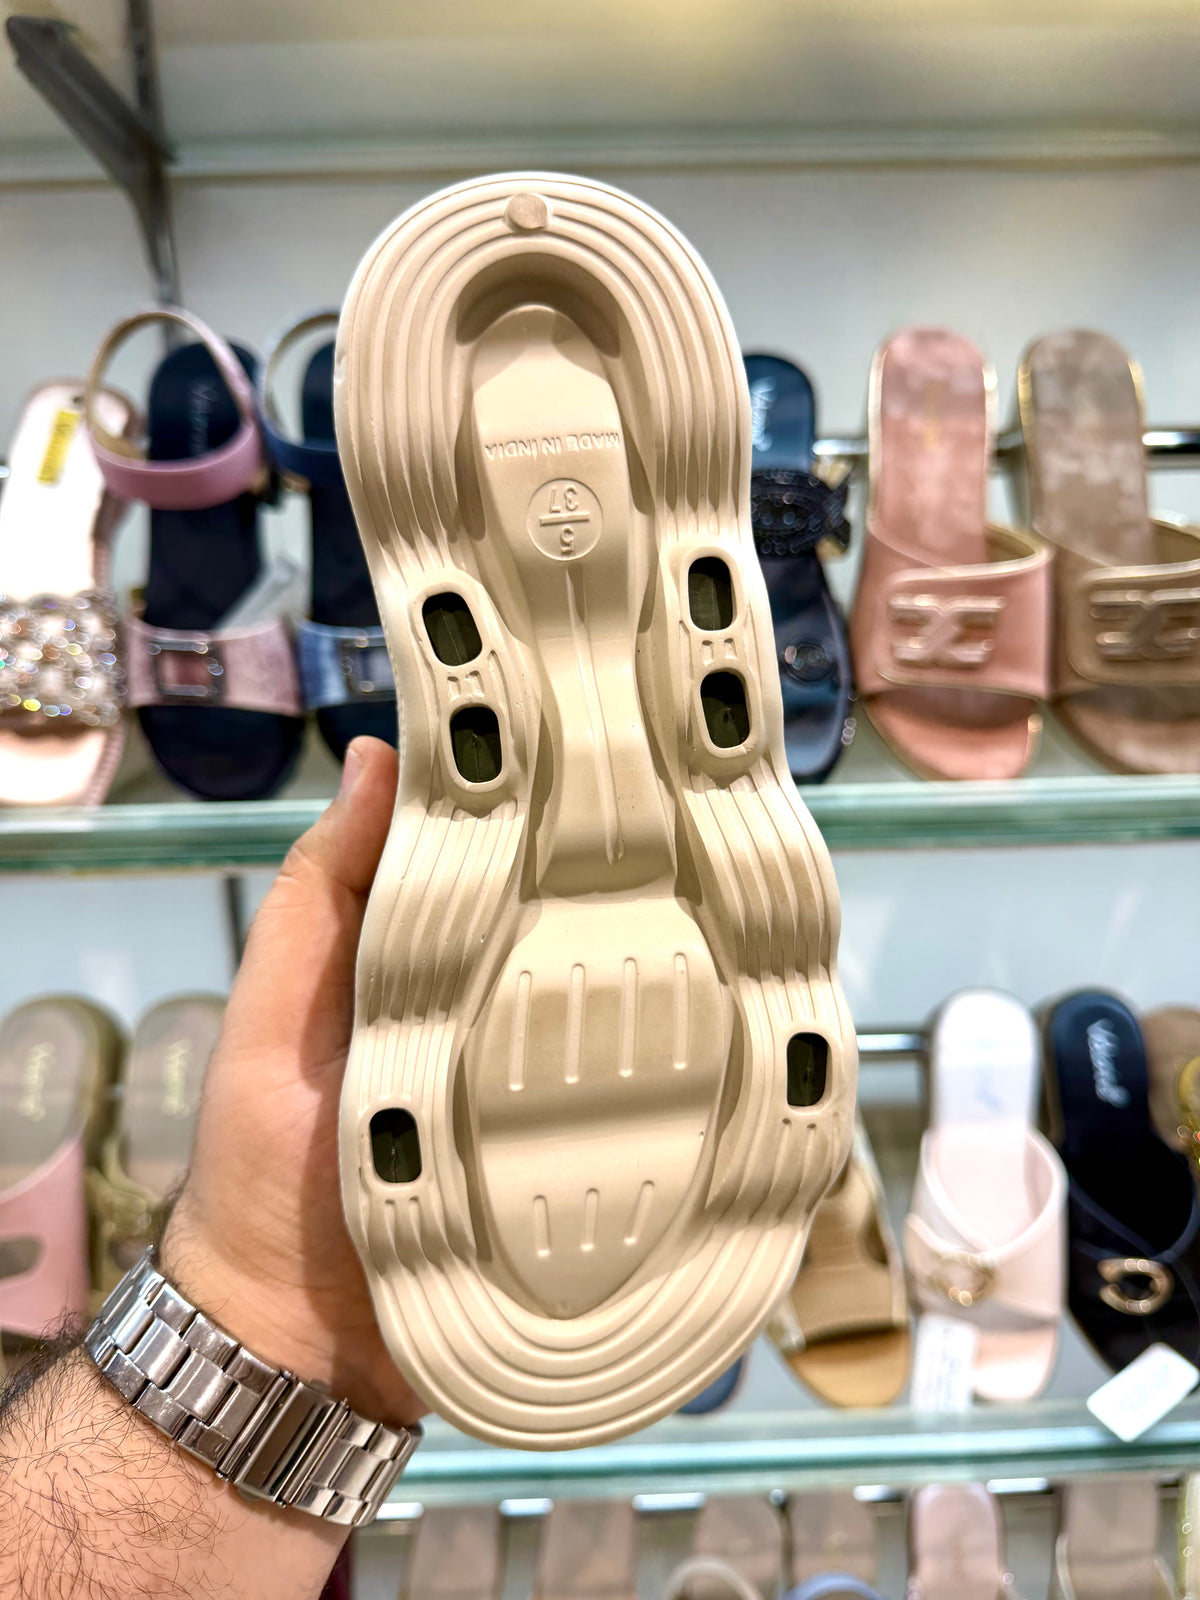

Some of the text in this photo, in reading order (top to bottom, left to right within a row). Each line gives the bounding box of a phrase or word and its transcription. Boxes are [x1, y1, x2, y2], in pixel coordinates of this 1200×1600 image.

[485, 432, 620, 460] MADE IN INDIA
[549, 484, 578, 513] 37
[560, 525, 575, 556] 5
